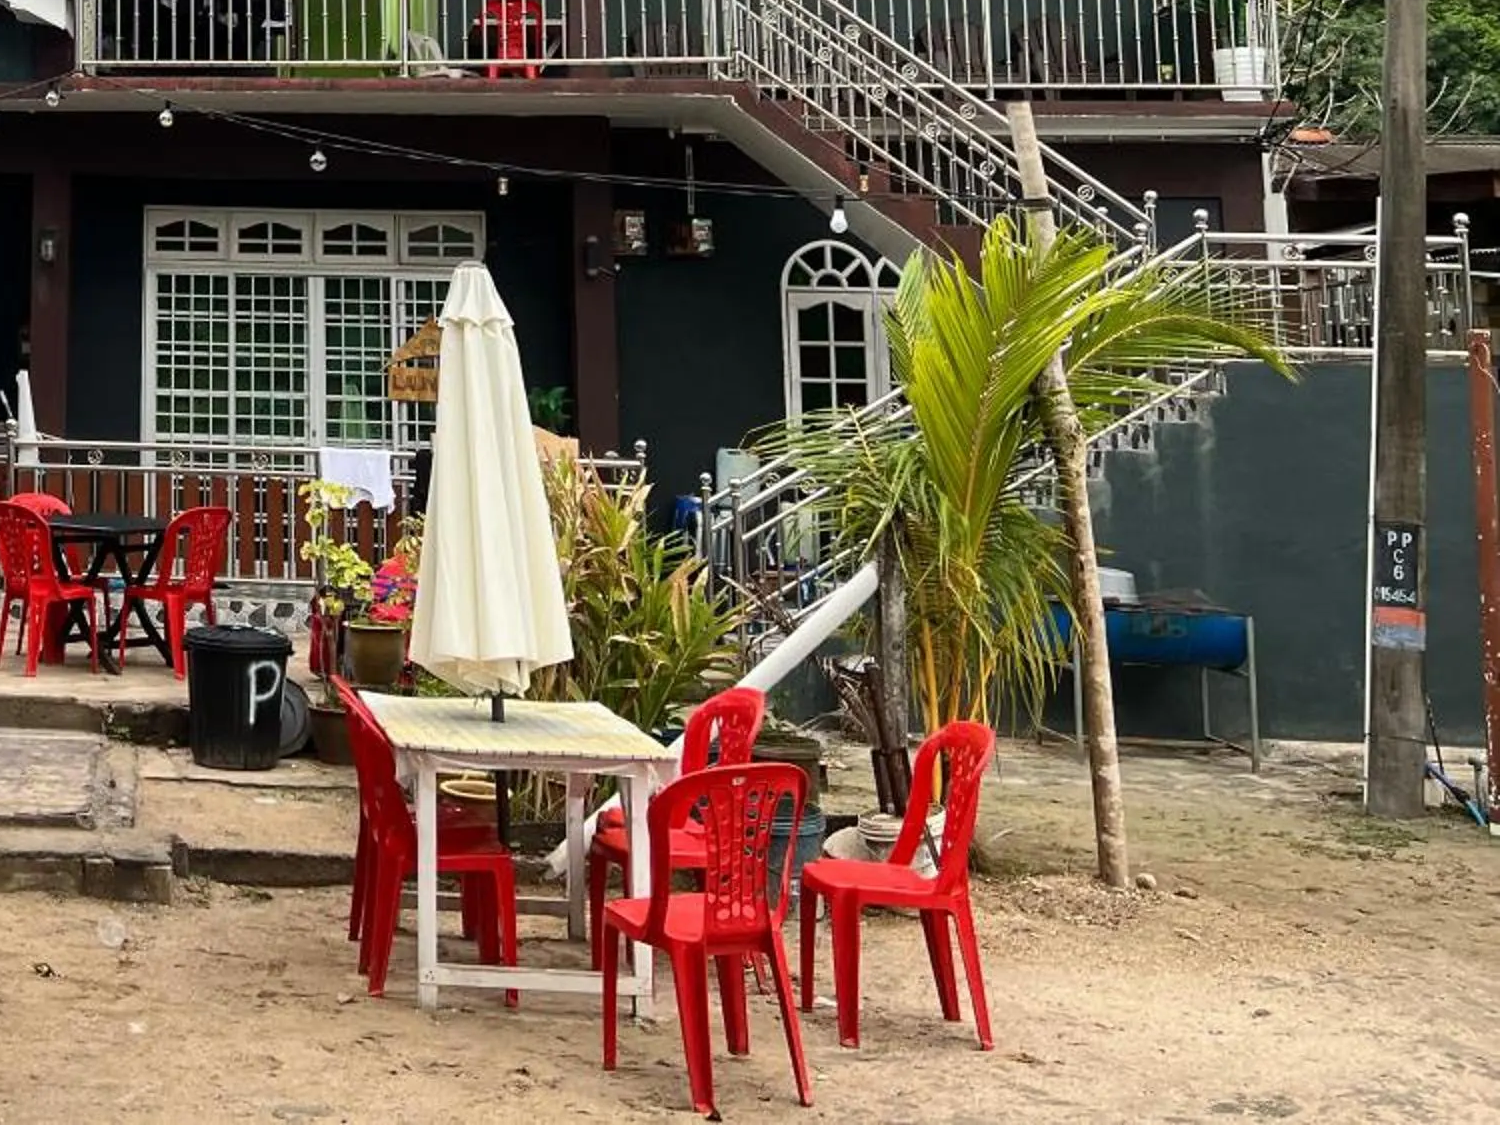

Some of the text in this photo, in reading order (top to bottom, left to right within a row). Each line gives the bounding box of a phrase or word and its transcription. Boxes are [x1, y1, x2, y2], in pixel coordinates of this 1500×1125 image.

[1393, 548, 1405, 564] C
[1393, 565, 1405, 580] 6
[249, 661, 281, 727] P
